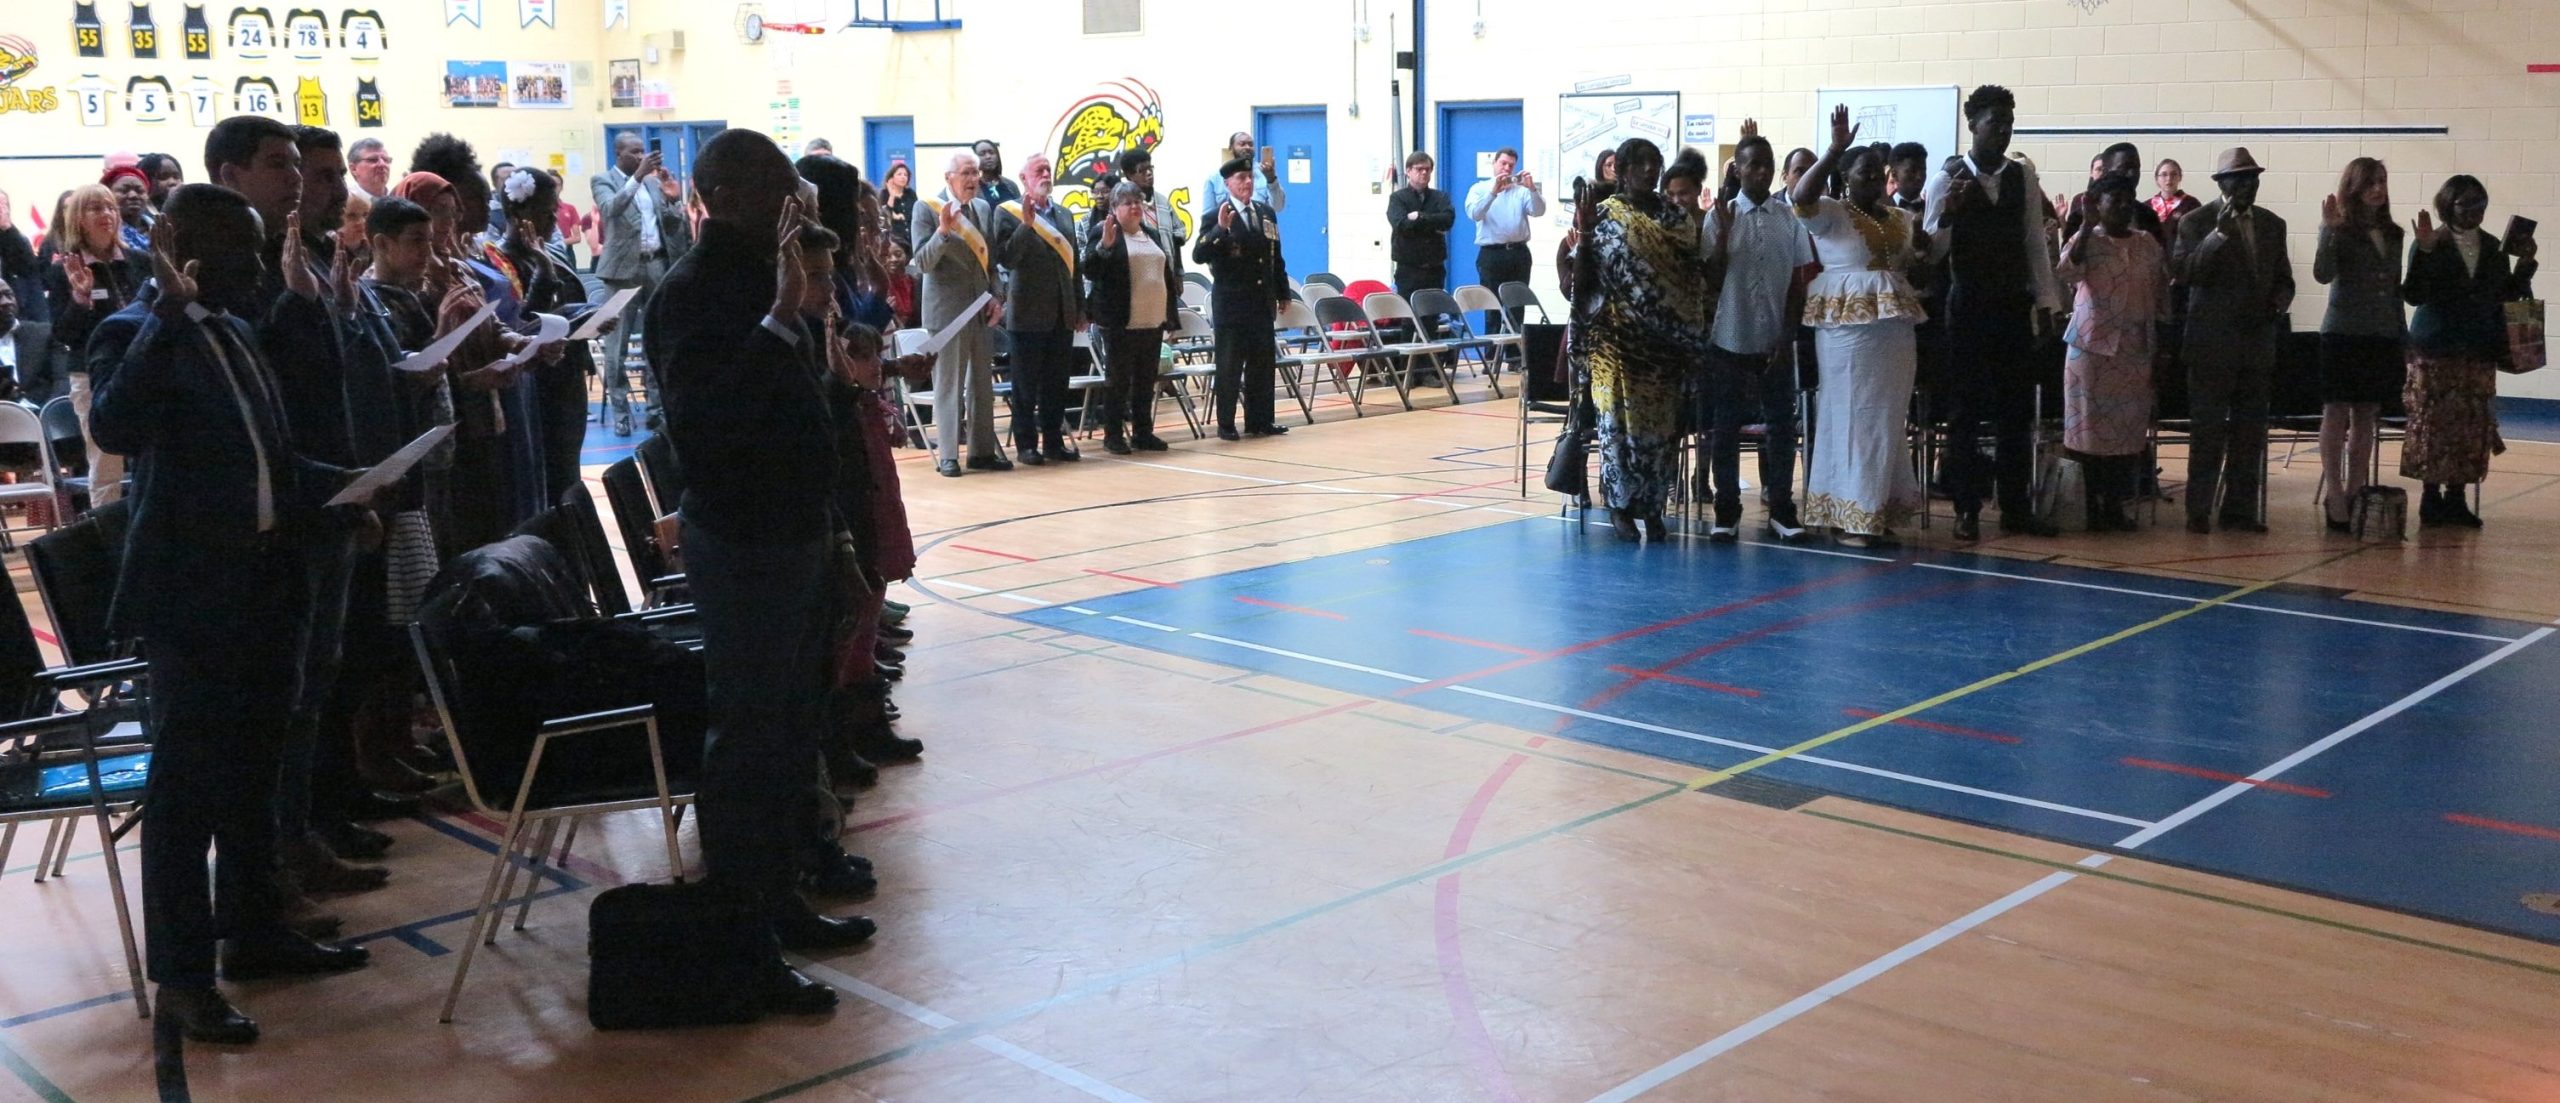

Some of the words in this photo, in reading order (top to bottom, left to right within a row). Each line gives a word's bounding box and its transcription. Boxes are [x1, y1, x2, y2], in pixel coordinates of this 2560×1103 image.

[79, 29, 98, 47] 55
[134, 31, 154, 48] 35
[187, 34, 207, 52] 55
[241, 29, 262, 46] 24
[298, 31, 317, 46] 78
[357, 31, 367, 49] 4
[88, 94, 98, 113] 5
[145, 94, 155, 112] 5
[197, 96, 207, 113] 7
[249, 94, 267, 112] 16
[303, 103, 319, 117] 13
[360, 100, 380, 120] 34
